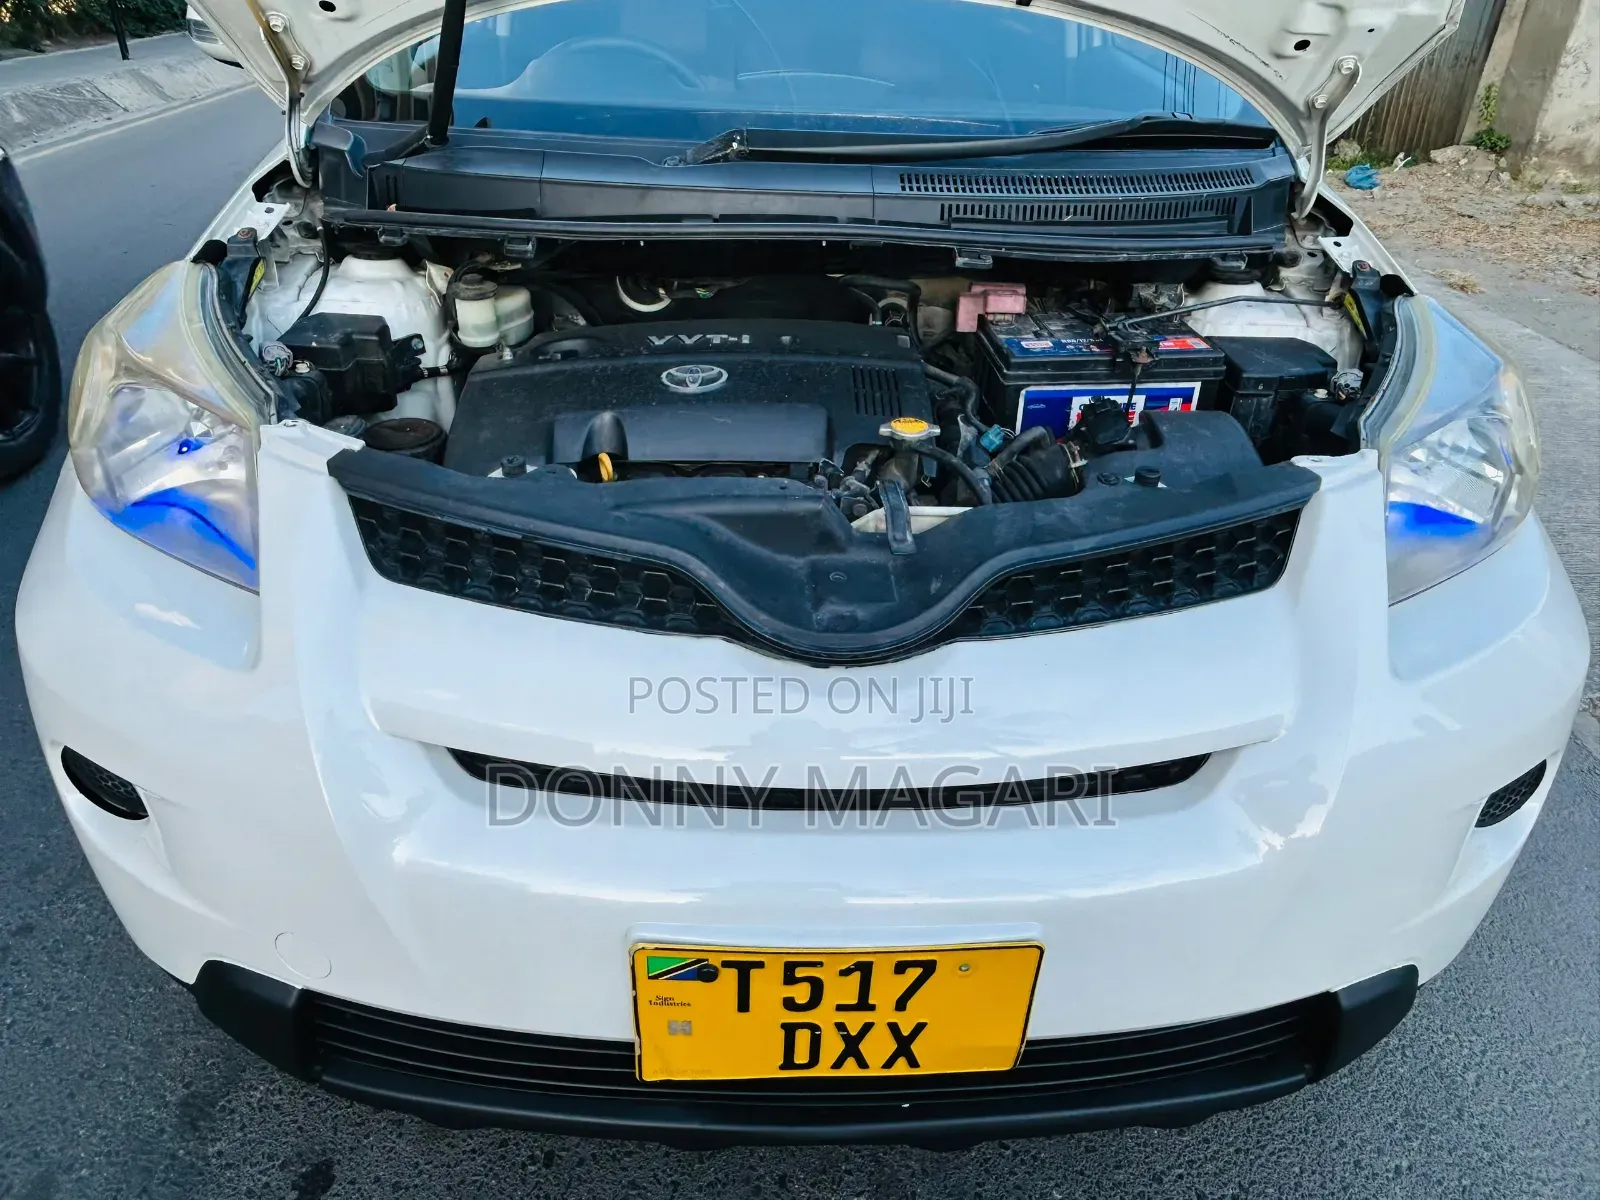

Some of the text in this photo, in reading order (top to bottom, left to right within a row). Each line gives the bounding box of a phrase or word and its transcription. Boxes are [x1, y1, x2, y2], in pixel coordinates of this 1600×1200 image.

[721, 959, 938, 1012] T 517
[779, 1021, 929, 1070] DXX
